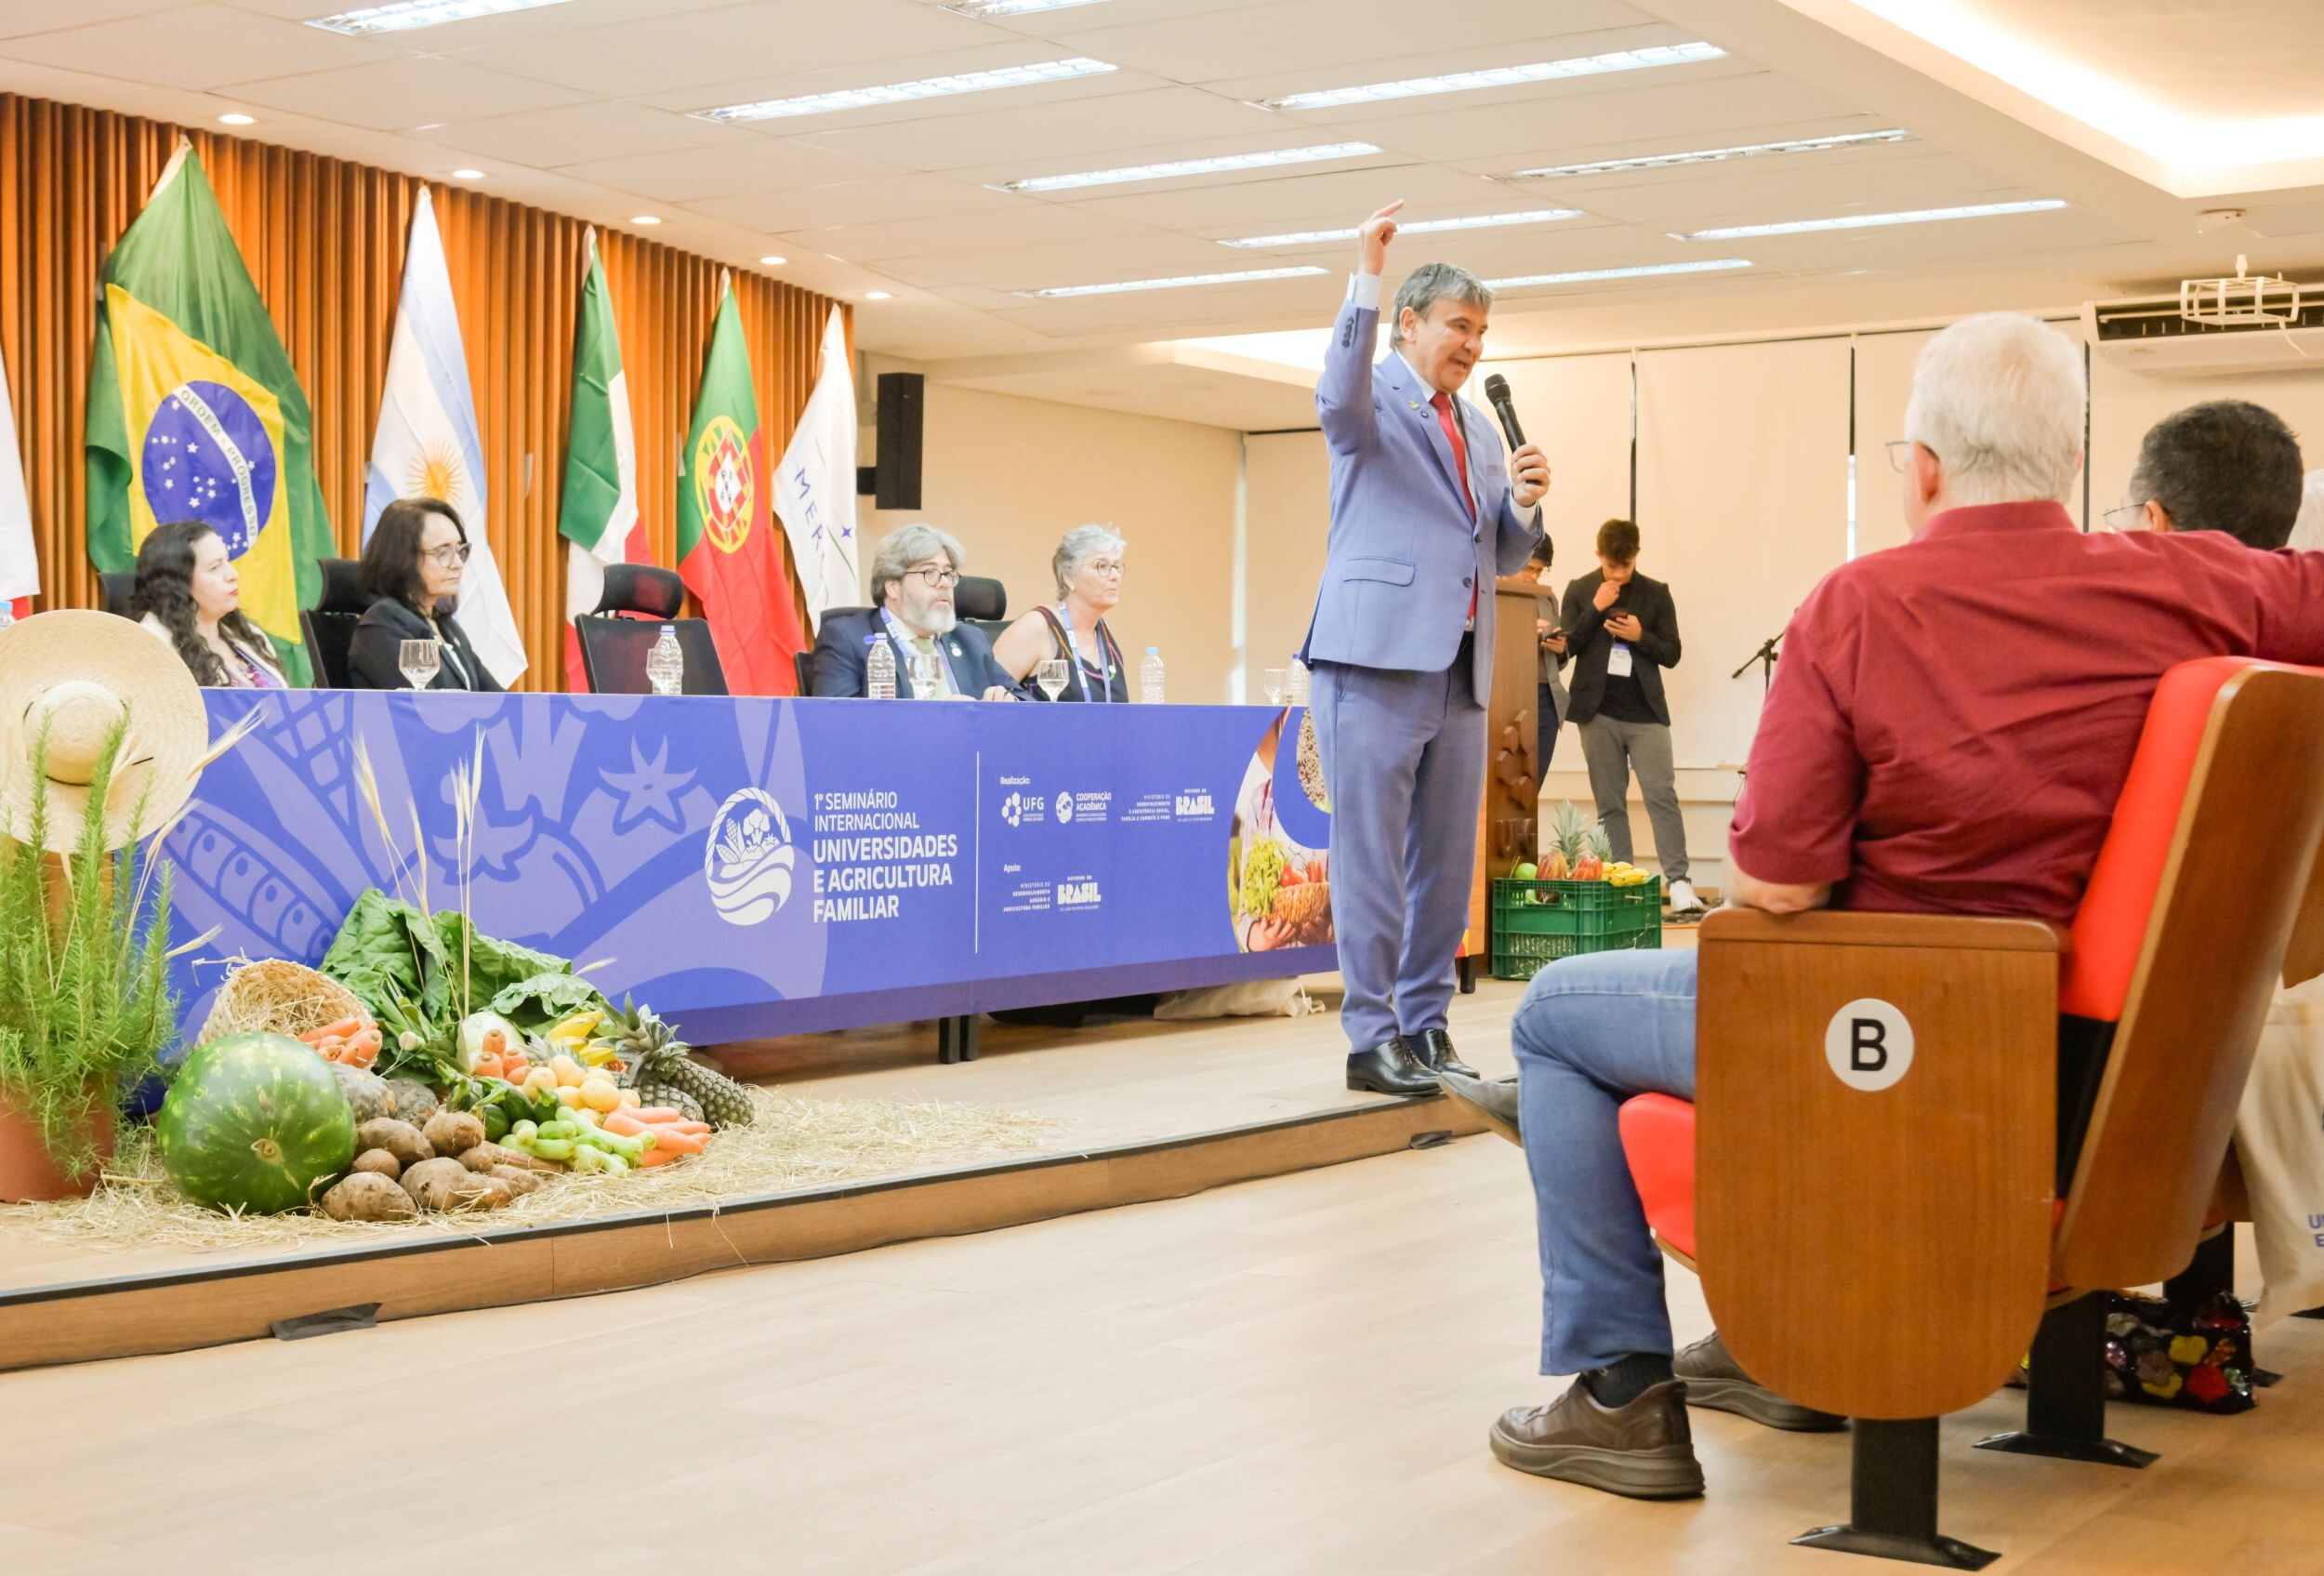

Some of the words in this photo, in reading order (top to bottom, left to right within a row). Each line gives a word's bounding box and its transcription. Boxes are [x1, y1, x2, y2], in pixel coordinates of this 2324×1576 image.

[180, 389, 222, 437] ORDEM
[226, 446, 257, 536] PROGRESSO
[1000, 775, 1031, 786] Realização:
[825, 788, 898, 811] SEMINÁRIO
[1023, 797, 1044, 811] UFG
[1076, 791, 1112, 801] COOPERAÇÃO
[1076, 801, 1107, 812] ACADÊMICA
[1175, 795, 1215, 815] BRASIL
[814, 812, 920, 832] INTERNACIONAL
[812, 833, 958, 864] UNIVERSIDADES
[812, 869, 825, 893] E
[827, 863, 953, 892] AGRICULTURA
[1057, 882, 1102, 905] BRASIL
[812, 894, 900, 922] FAMILIAR
[1851, 1017, 1888, 1072] B
[2308, 1213, 2324, 1229] U
